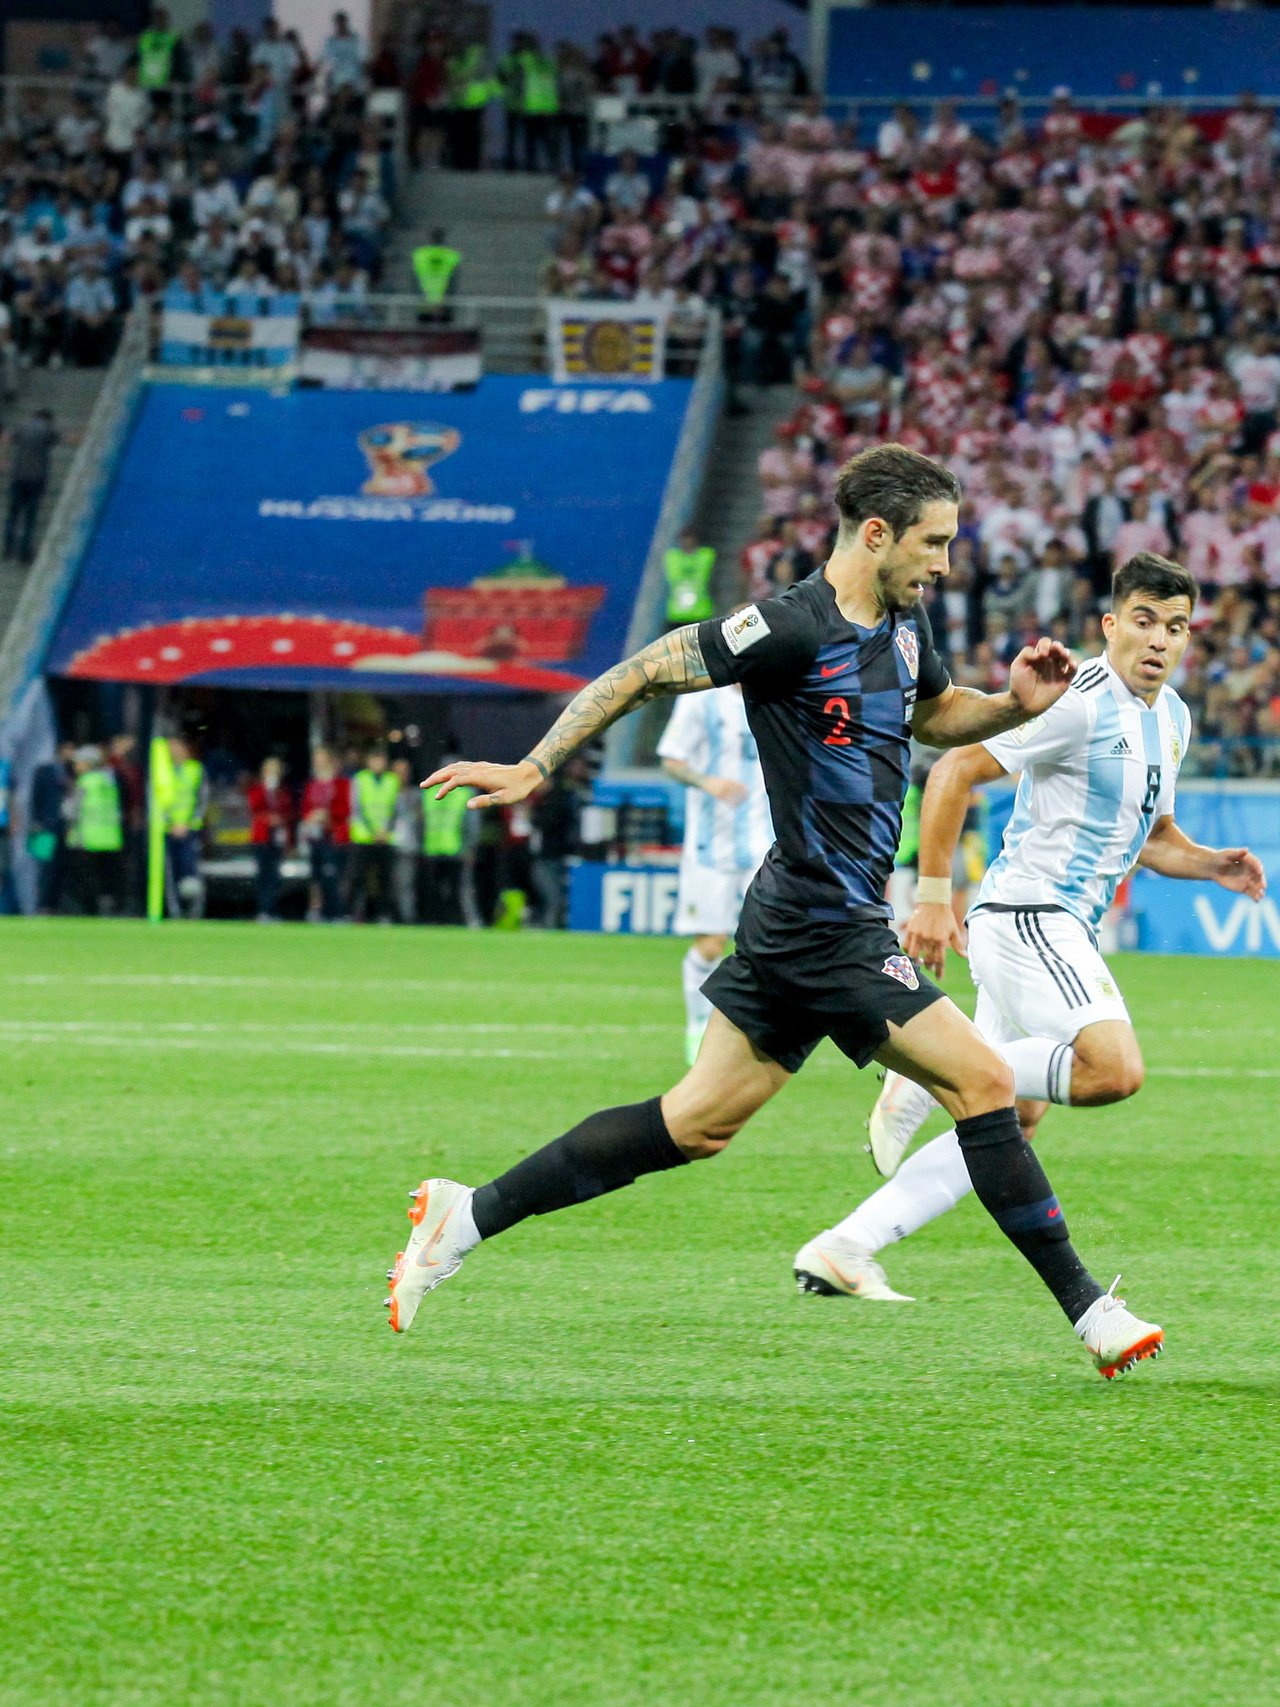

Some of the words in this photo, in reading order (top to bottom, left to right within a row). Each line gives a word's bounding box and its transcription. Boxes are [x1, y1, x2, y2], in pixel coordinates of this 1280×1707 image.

[519, 389, 655, 413] FIFA
[823, 697, 852, 745] 2
[1141, 764, 1161, 814] 8
[602, 871, 678, 933] FIF
